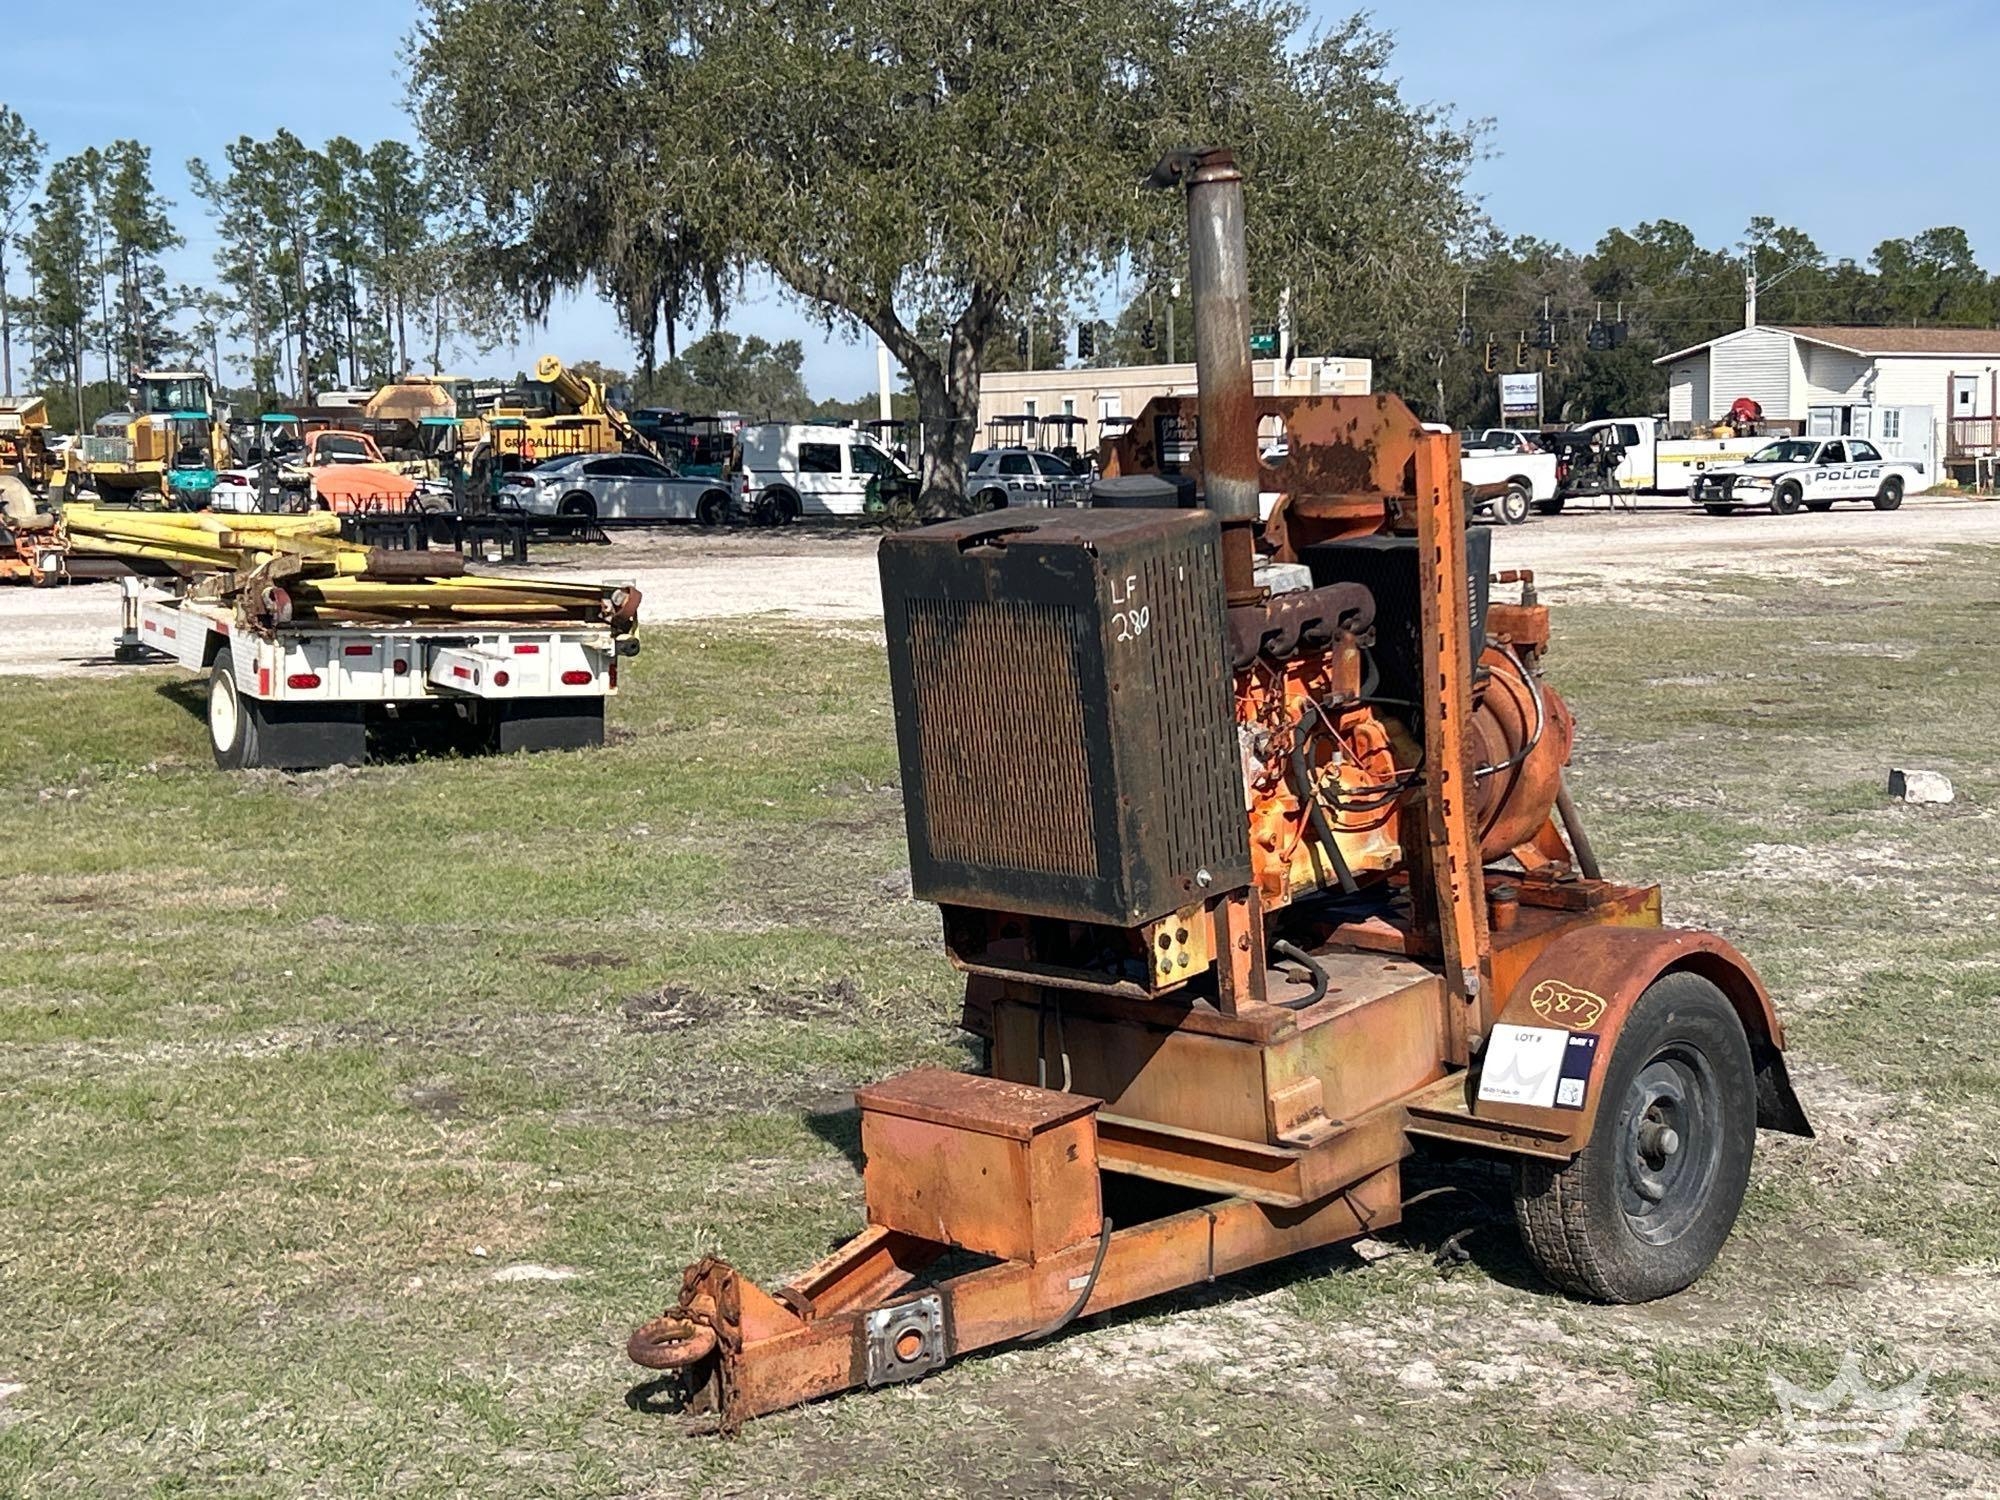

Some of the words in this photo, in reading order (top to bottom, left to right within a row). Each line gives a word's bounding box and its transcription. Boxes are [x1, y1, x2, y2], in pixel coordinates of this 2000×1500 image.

[1815, 469, 1881, 482] POLICE
[1110, 575, 1137, 604] LF
[1111, 605, 1150, 642] 280
[1515, 1033, 1533, 1042] LOT
